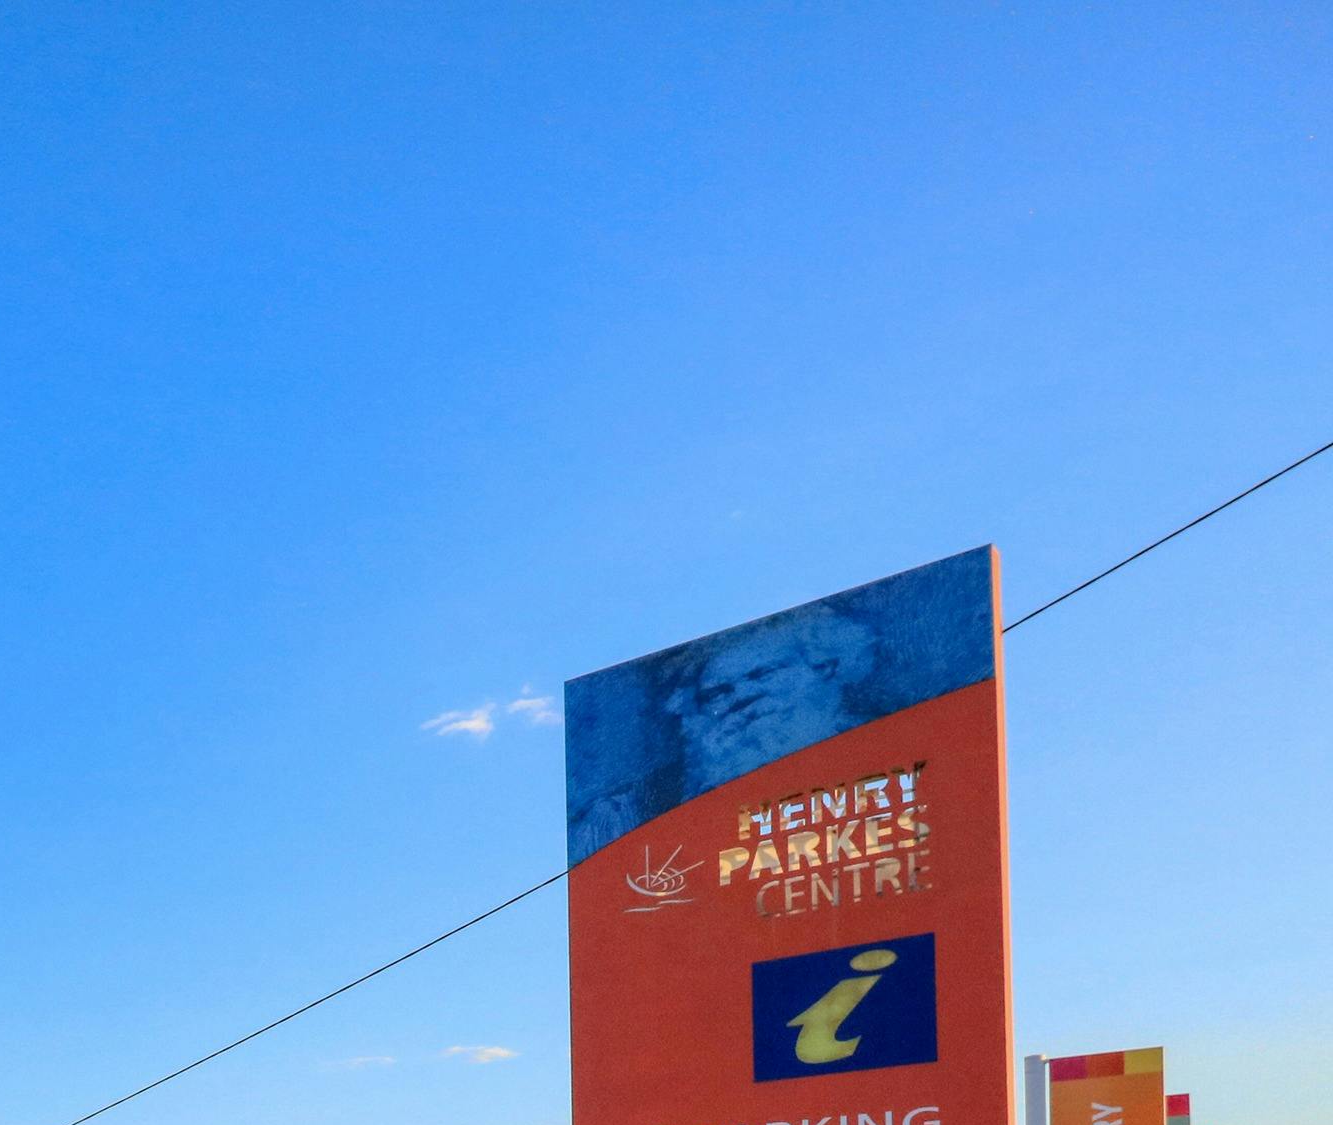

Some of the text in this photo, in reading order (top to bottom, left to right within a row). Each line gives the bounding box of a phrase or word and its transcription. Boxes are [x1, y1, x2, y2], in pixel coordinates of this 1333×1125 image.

[738, 761, 927, 841] HENRY
[719, 805, 930, 886] PARKES
[756, 849, 933, 918] CENTRE
